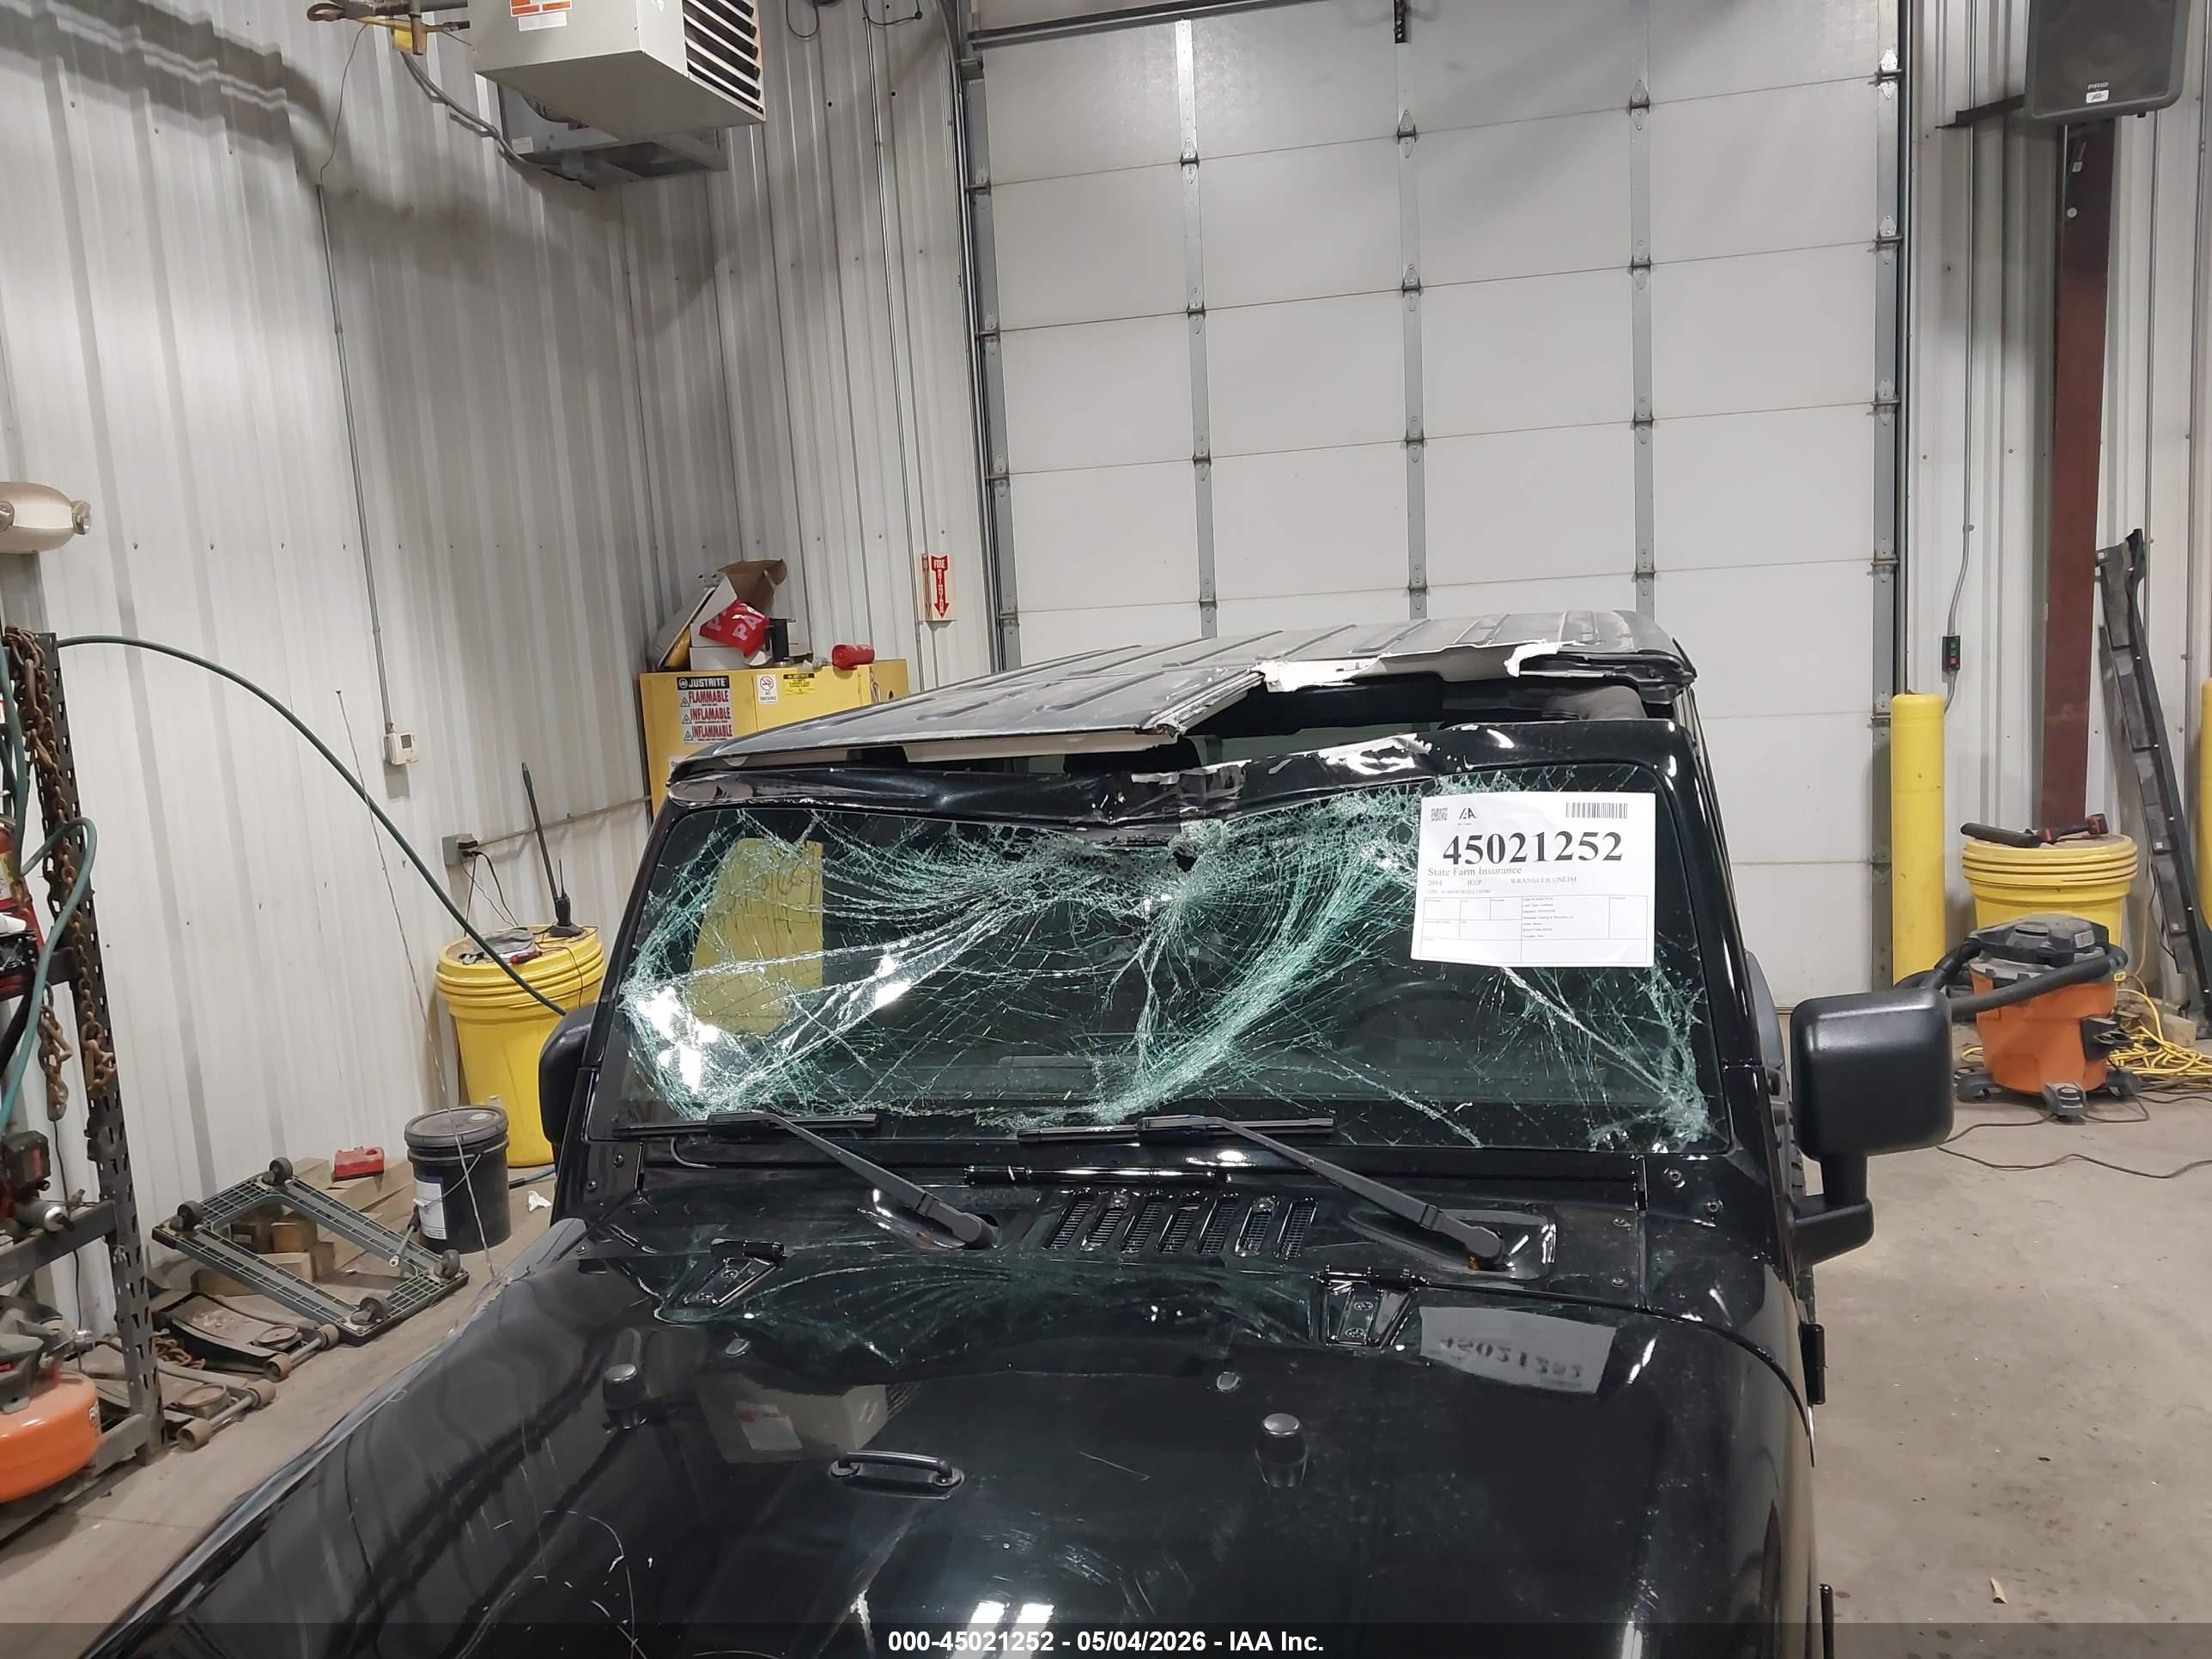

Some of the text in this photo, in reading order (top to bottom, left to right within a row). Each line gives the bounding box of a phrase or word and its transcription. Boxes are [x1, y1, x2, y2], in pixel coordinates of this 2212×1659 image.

[689, 678, 726, 688] JUSTRITE
[689, 690, 729, 703] FLAMMABLE
[690, 707, 731, 720] INFLAMABLE
[691, 725, 732, 738] INFLAMMABLE
[1443, 830, 1623, 865] 45021252
[1427, 866, 1522, 877] State Farm Insurance
